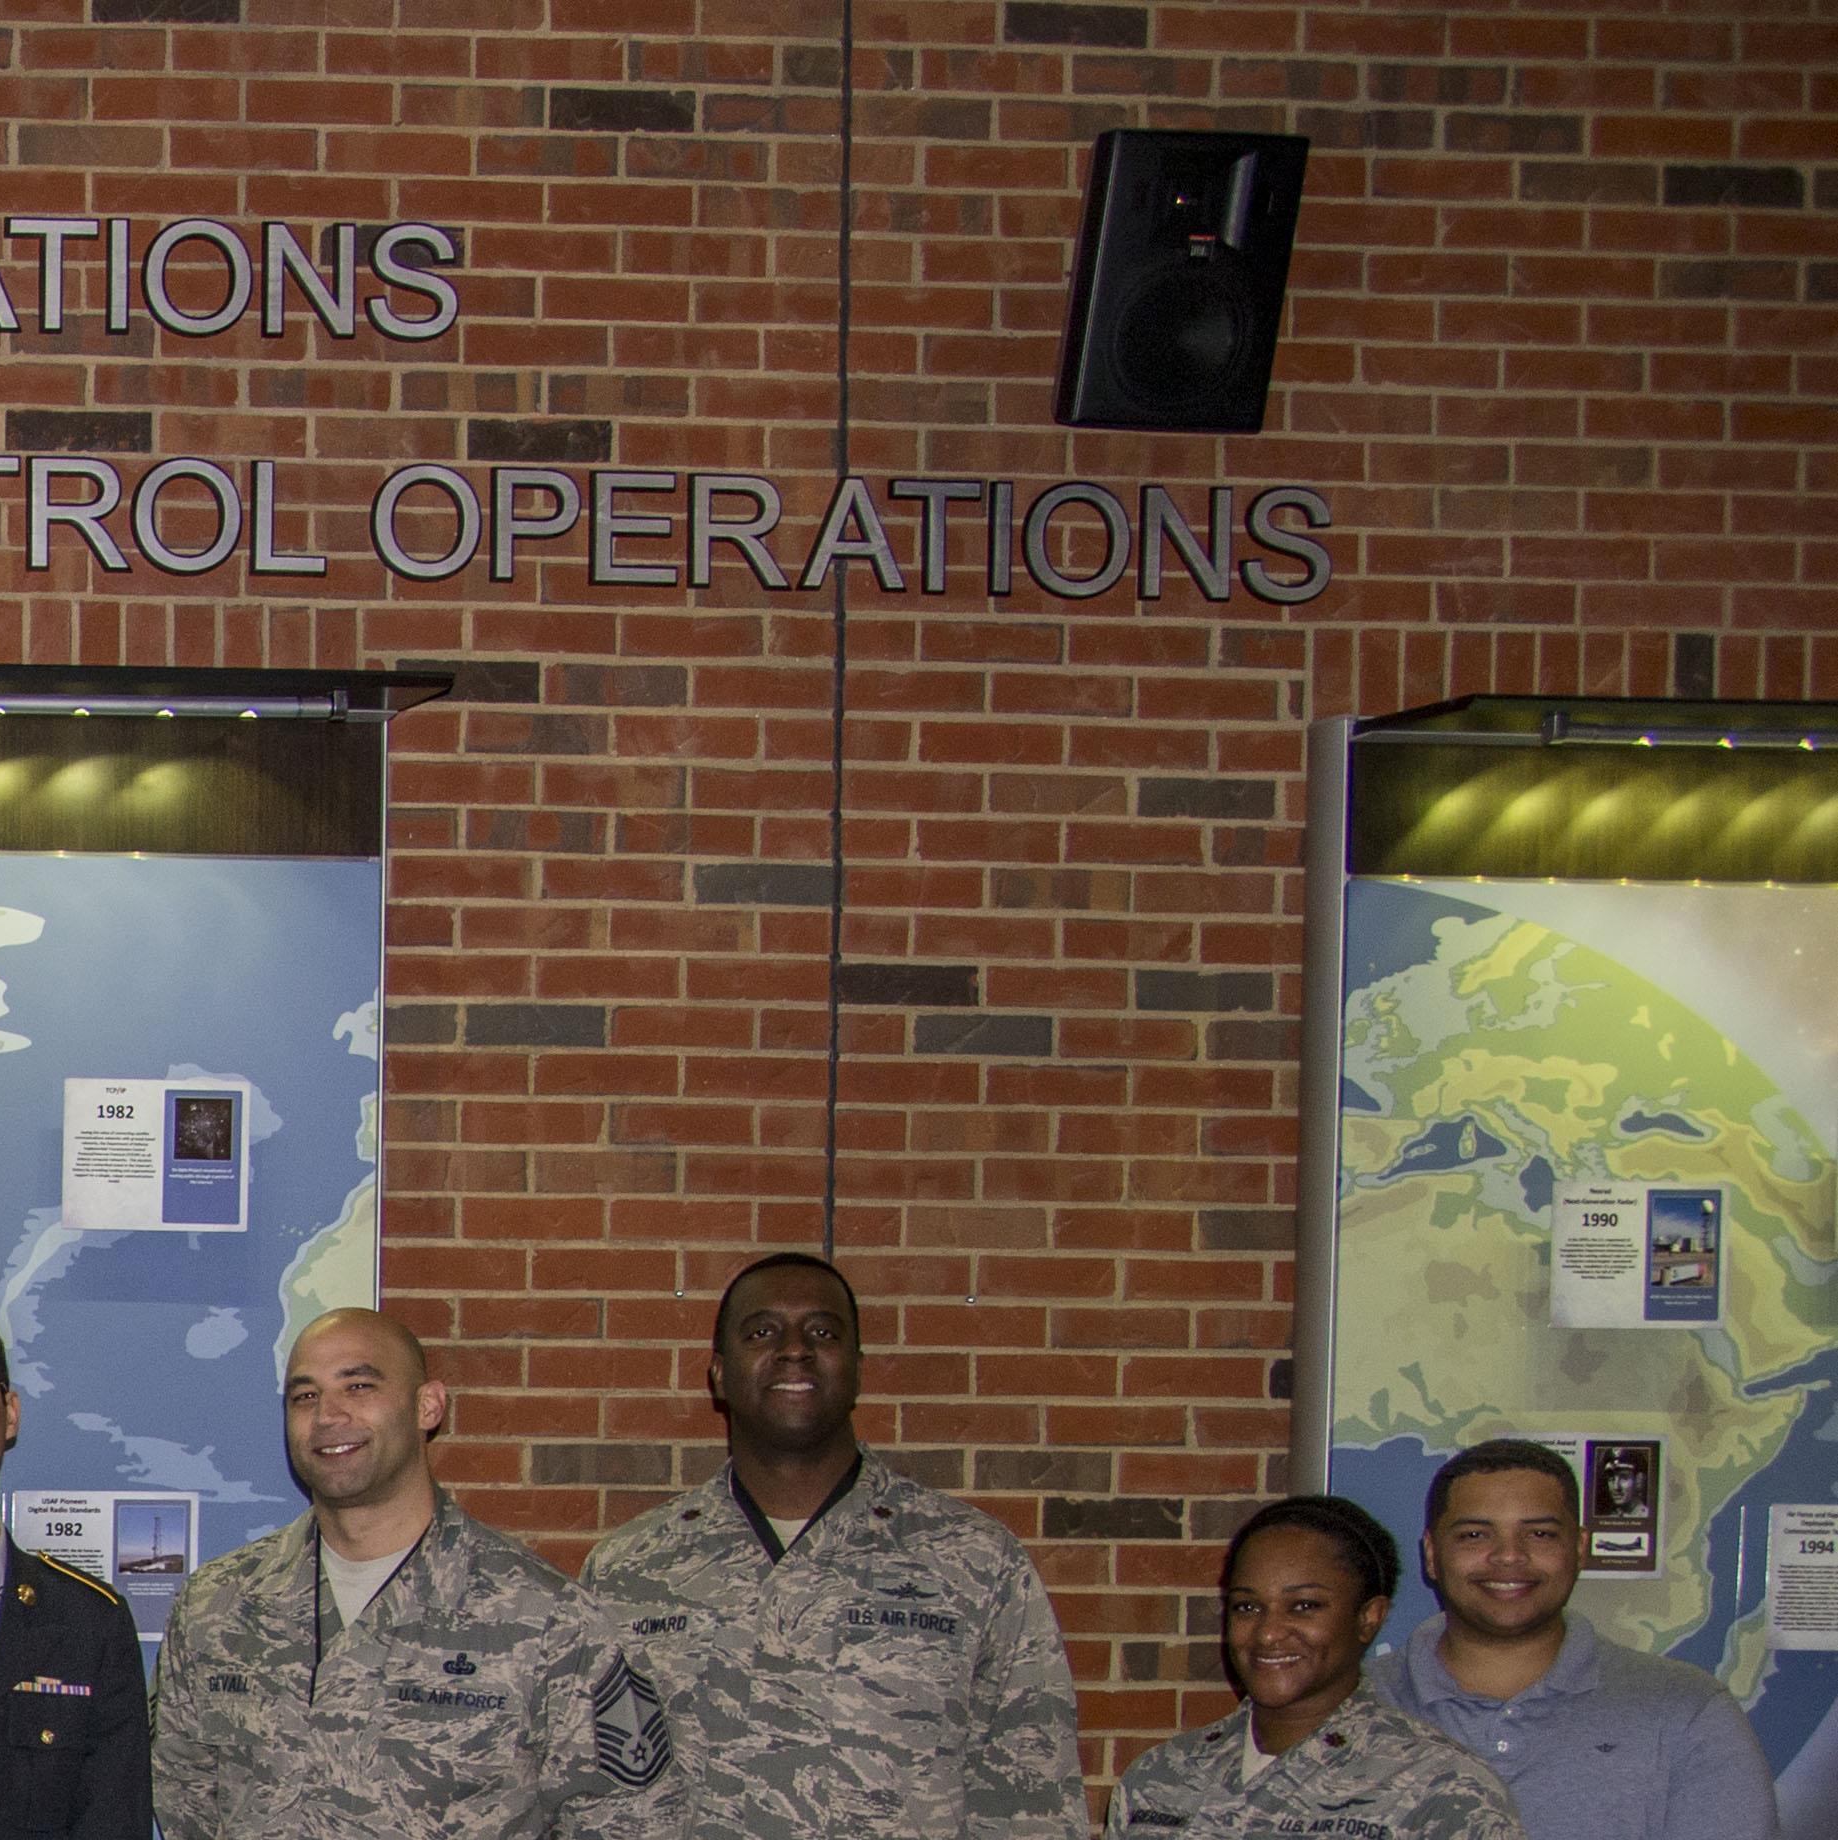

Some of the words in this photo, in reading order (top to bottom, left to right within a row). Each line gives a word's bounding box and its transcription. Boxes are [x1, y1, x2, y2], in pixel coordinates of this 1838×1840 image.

[371, 462, 1331, 606] OPERATIONS
[96, 1105, 135, 1119] 1982
[1582, 1213, 1618, 1227] 1990
[45, 1522, 83, 1536] 1982
[1799, 1540, 1834, 1554] 1994
[879, 1610, 906, 1627] AIR
[909, 1613, 957, 1635] FORCE
[428, 1689, 454, 1705] AIR
[455, 1692, 507, 1710] FORCE
[1308, 1820, 1334, 1832] AIR
[1337, 1819, 1389, 1840] FORCE
